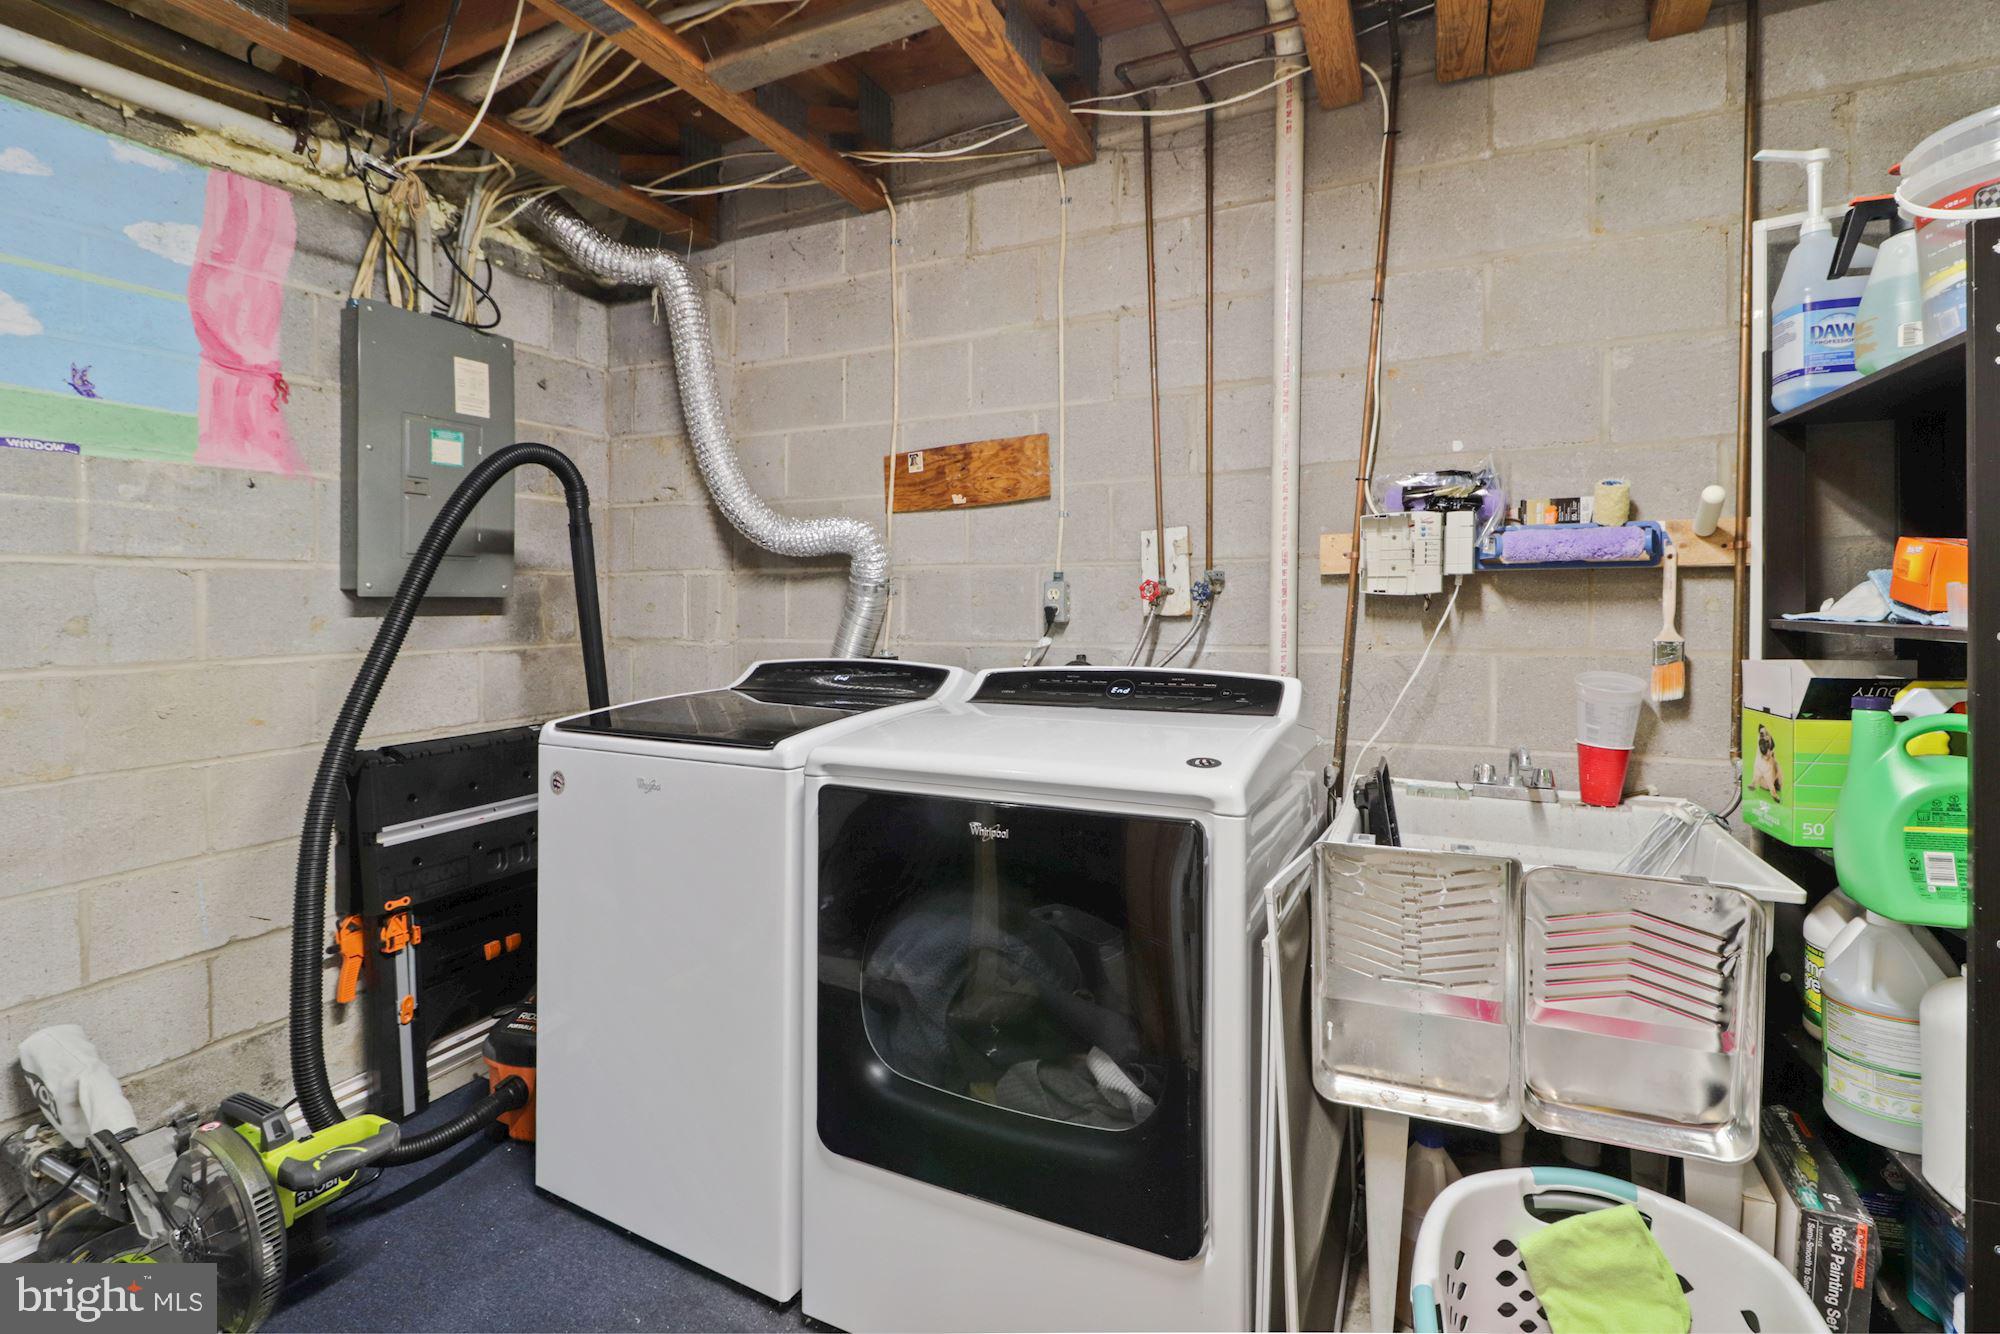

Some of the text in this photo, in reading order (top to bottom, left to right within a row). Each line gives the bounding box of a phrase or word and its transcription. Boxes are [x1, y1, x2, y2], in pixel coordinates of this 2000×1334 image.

[1110, 686, 1131, 694] End
[968, 821, 1009, 842] Whirlpool
[1802, 822, 1825, 836] 50
[1805, 1222, 1816, 1267] Semi-Smooth
[1804, 1267, 1813, 1275] to
[1824, 1226, 1847, 1331] 6pc Painting Set
